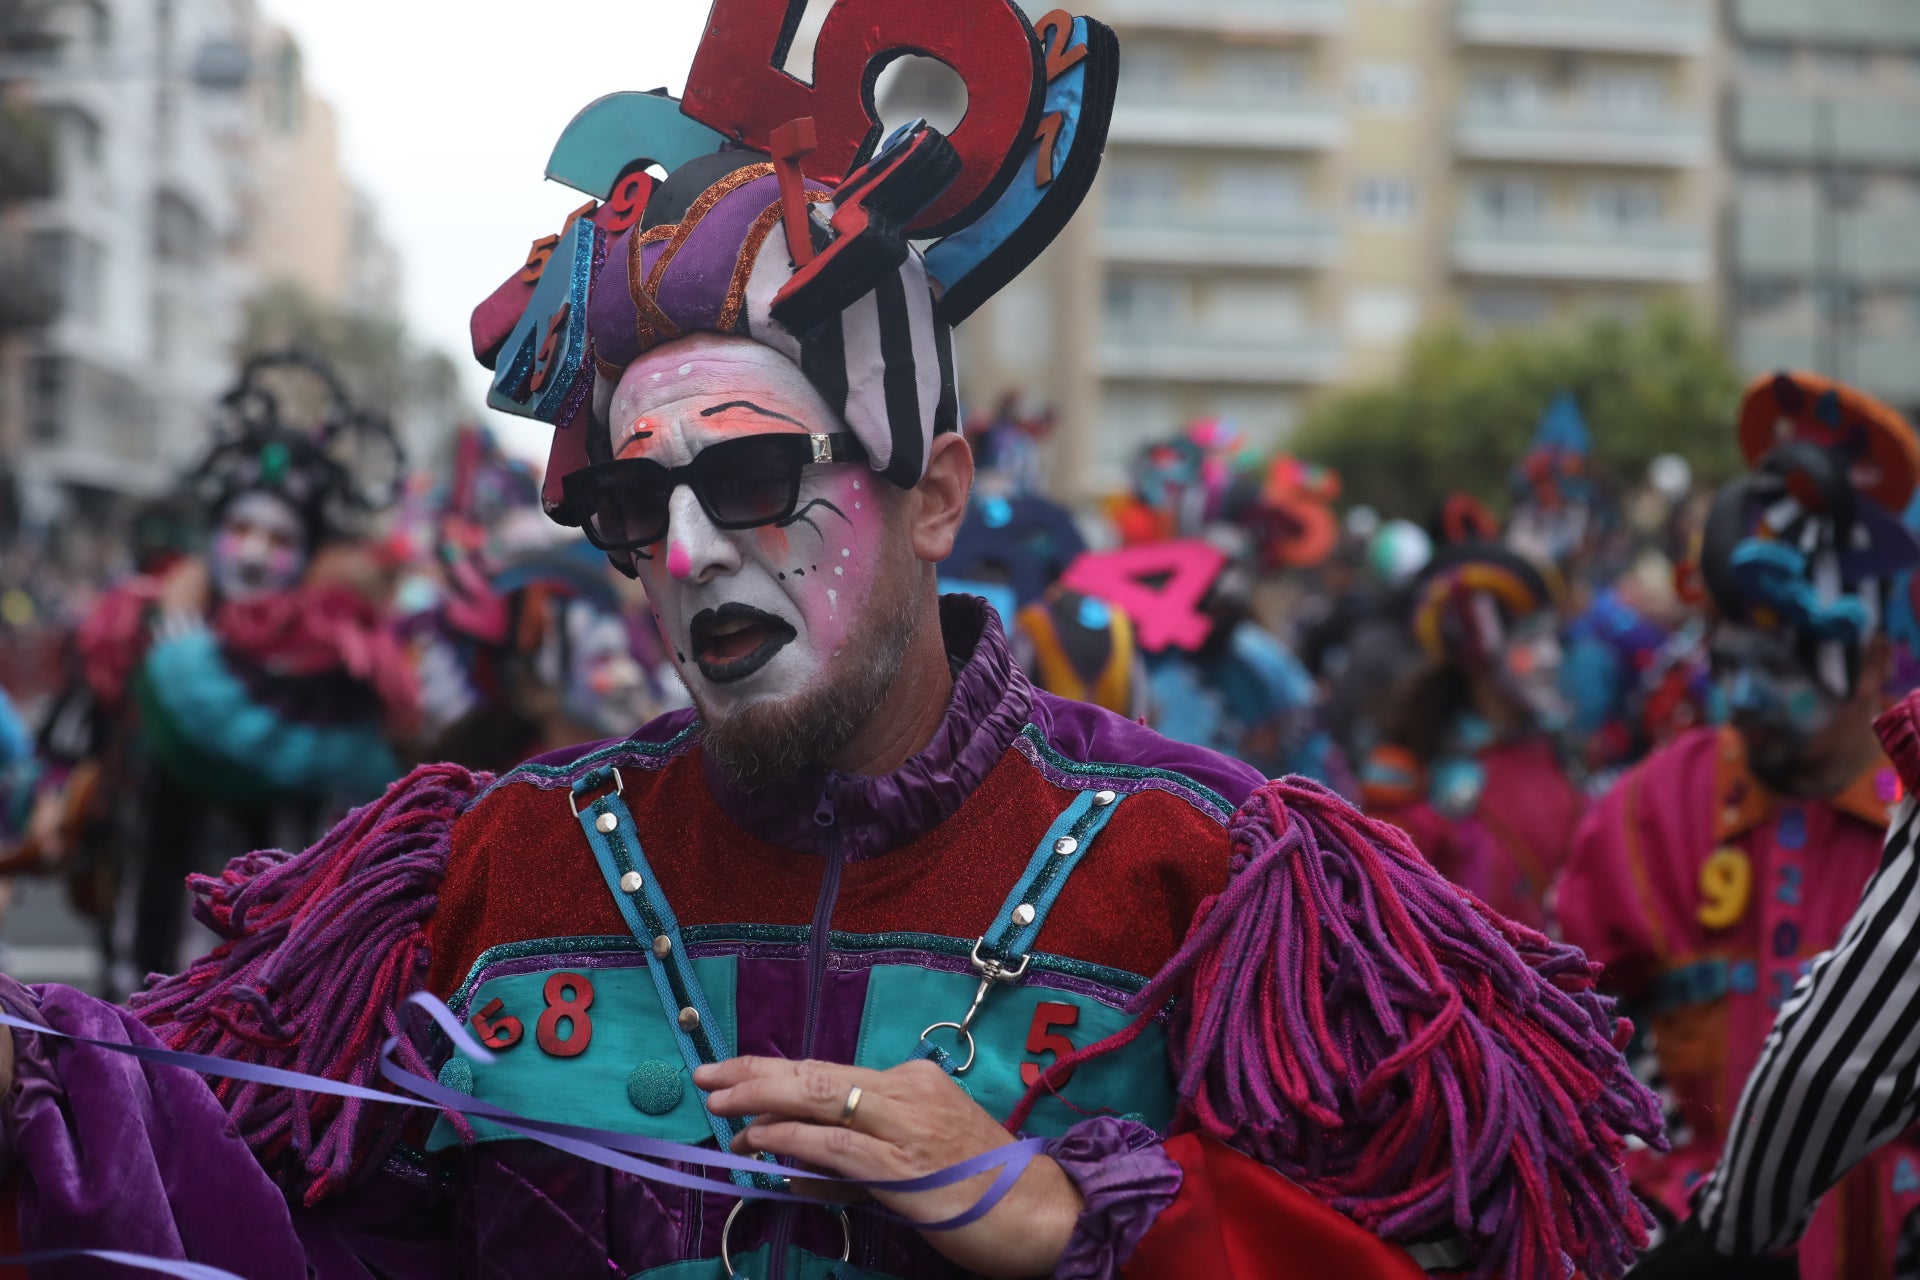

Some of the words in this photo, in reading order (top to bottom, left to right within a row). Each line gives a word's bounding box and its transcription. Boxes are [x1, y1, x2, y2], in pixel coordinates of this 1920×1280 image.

[1034, 9, 1088, 82] 2
[606, 171, 653, 232] 9
[1058, 540, 1228, 652] 4
[1699, 851, 1750, 929] 9
[536, 972, 594, 1058] 8
[1020, 1001, 1079, 1092] 5
